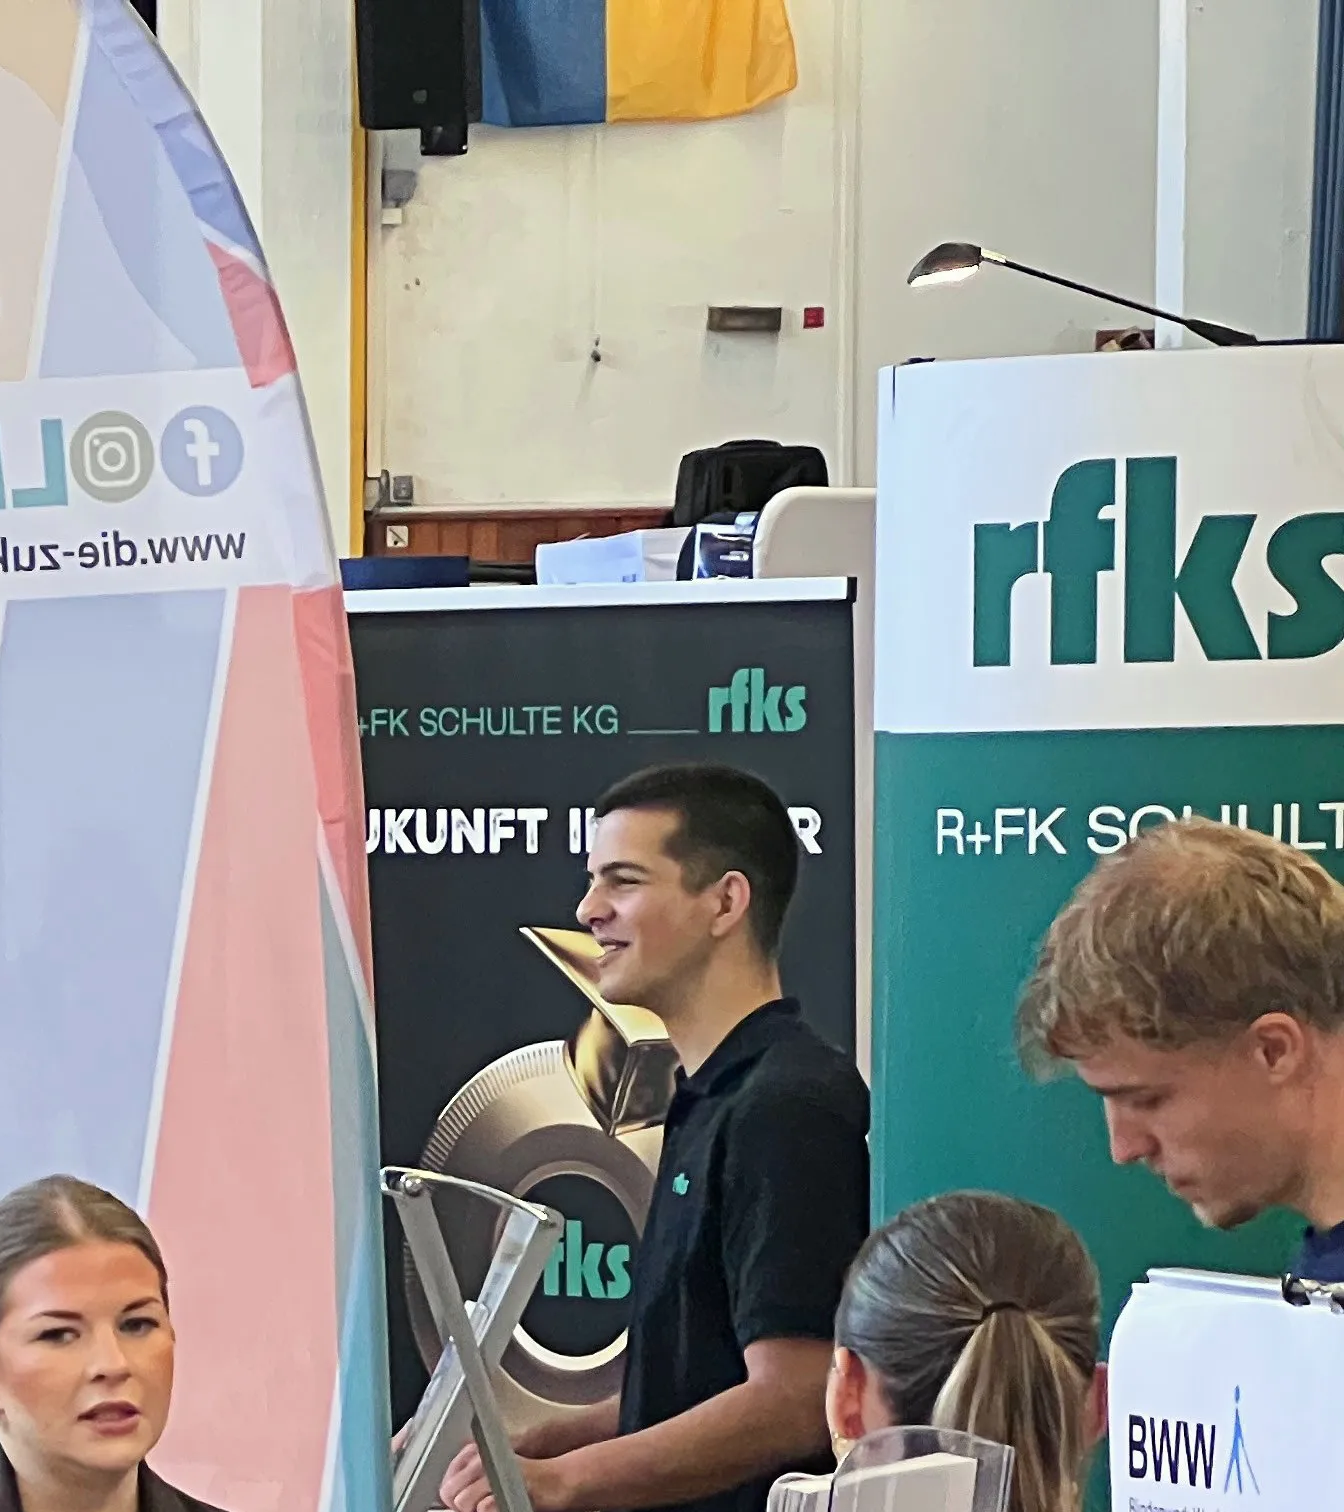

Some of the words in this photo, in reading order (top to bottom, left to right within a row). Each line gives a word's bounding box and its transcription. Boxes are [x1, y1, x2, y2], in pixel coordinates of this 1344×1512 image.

[972, 455, 1344, 668] rfks
[357, 706, 410, 737] +FK
[419, 705, 562, 737] SCHULTE
[573, 703, 620, 735] KG
[708, 667, 807, 734] rfks
[365, 807, 548, 856] UKUNFT
[936, 806, 1068, 856] R+FK
[1128, 1413, 1216, 1490] BWW
